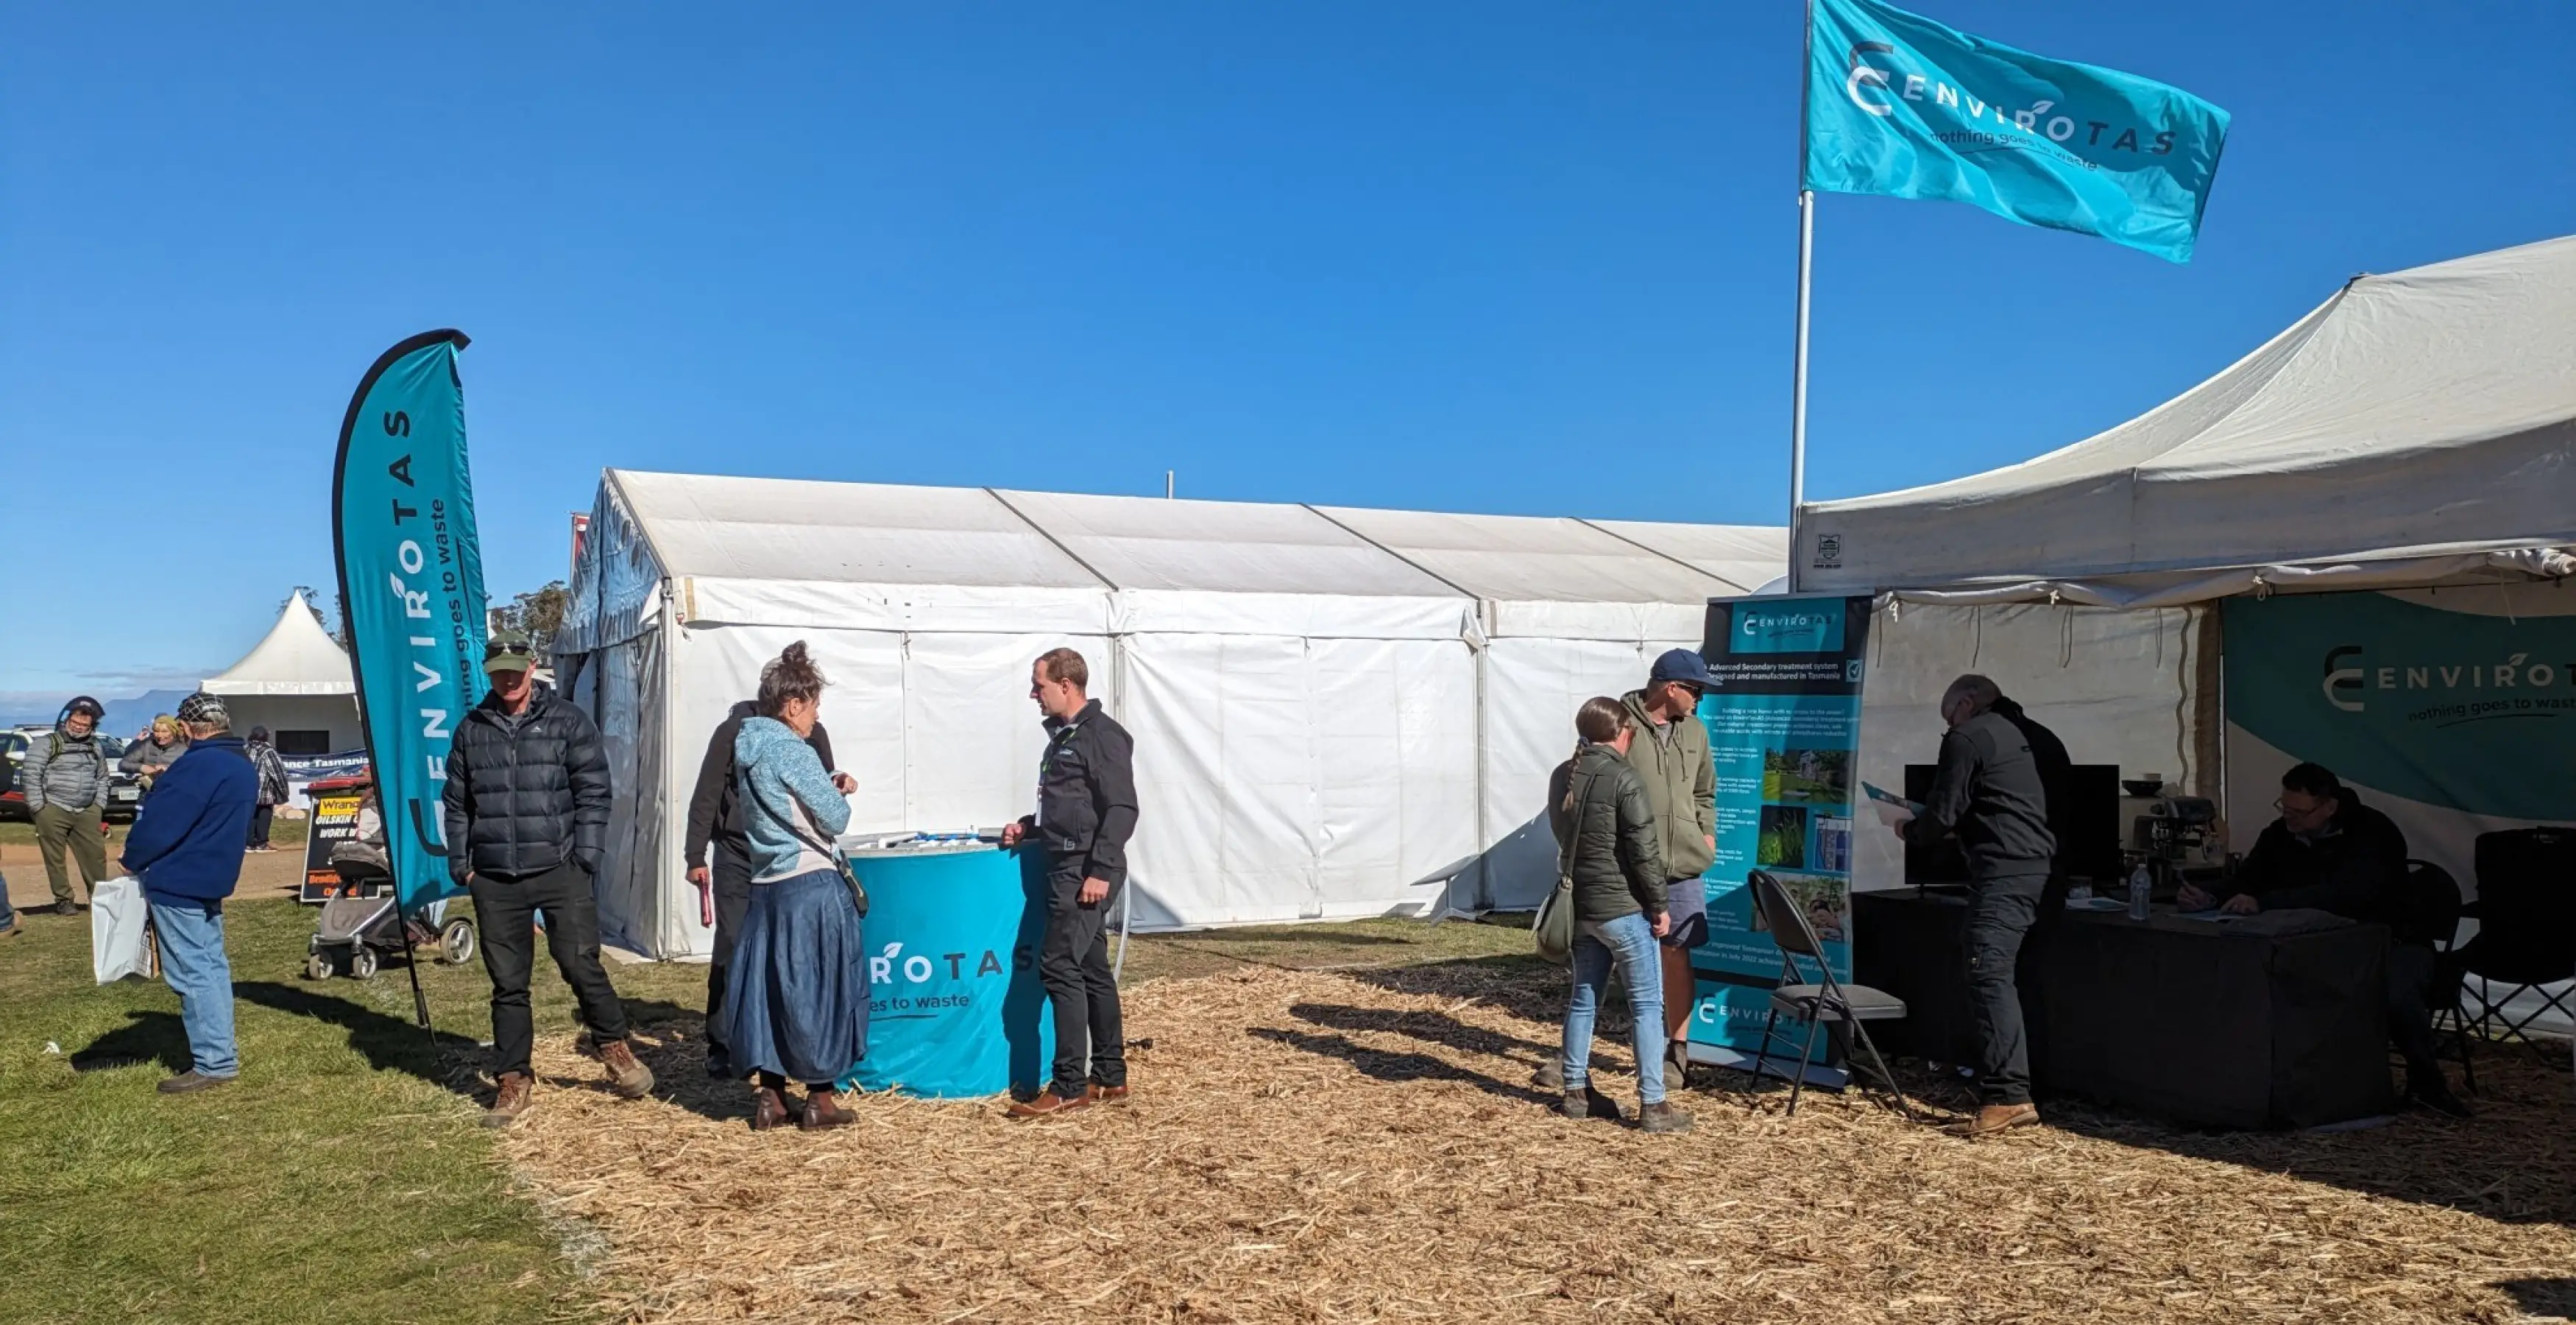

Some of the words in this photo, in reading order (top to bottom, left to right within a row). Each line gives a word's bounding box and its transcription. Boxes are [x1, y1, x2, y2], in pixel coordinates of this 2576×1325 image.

[1903, 74, 2176, 155] ENVIROTAS
[1930, 130, 1995, 145] nothing
[1999, 133, 2034, 146] goes
[2054, 149, 2098, 172] waste
[431, 498, 452, 566] waste
[442, 570, 457, 594] to
[383, 410, 450, 781] ENVIROTAS
[448, 598, 470, 653] goes
[1759, 616, 1832, 627] ENVIROTAS
[1742, 663, 1777, 671] Secondary
[1814, 663, 1839, 671] system
[2408, 704, 2465, 721] nothing
[2471, 699, 2510, 715] goes
[2515, 698, 2531, 709] to
[314, 757, 369, 768] Tasmania
[315, 816, 351, 824] OILSKIN
[319, 827, 347, 838] WORK
[892, 997, 910, 1008] to
[916, 994, 969, 1008] waste
